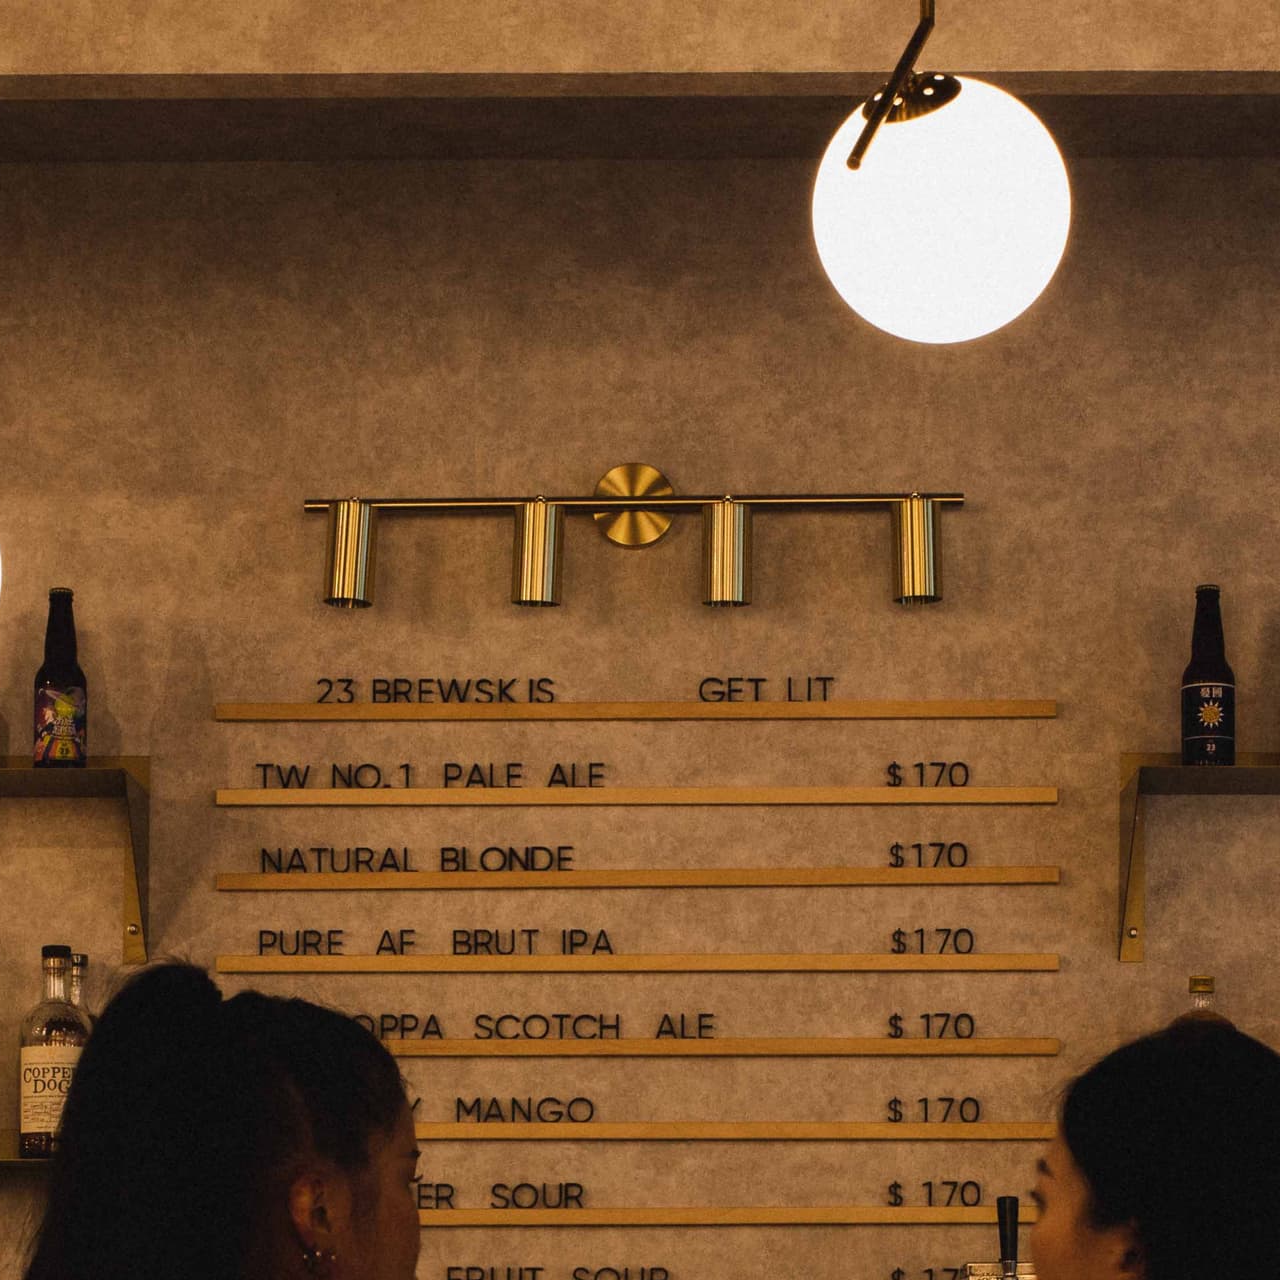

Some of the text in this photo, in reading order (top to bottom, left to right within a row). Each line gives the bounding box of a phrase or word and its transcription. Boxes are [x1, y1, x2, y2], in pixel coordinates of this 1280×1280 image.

[317, 679, 354, 702] 23
[699, 677, 834, 701] GET LIT
[256, 764, 310, 788] TW
[444, 763, 522, 787] PALE
[548, 763, 604, 786] ALE
[260, 847, 573, 873] NATURAL BLONDE
[260, 930, 613, 954] PURE AF BRUT IPA
[475, 1014, 619, 1038] SCOTCH
[656, 1014, 714, 1038] ALE
[24, 1067, 71, 1083] COPPE
[457, 1098, 594, 1122] MANGO
[417, 1183, 583, 1209] ER SOUR
